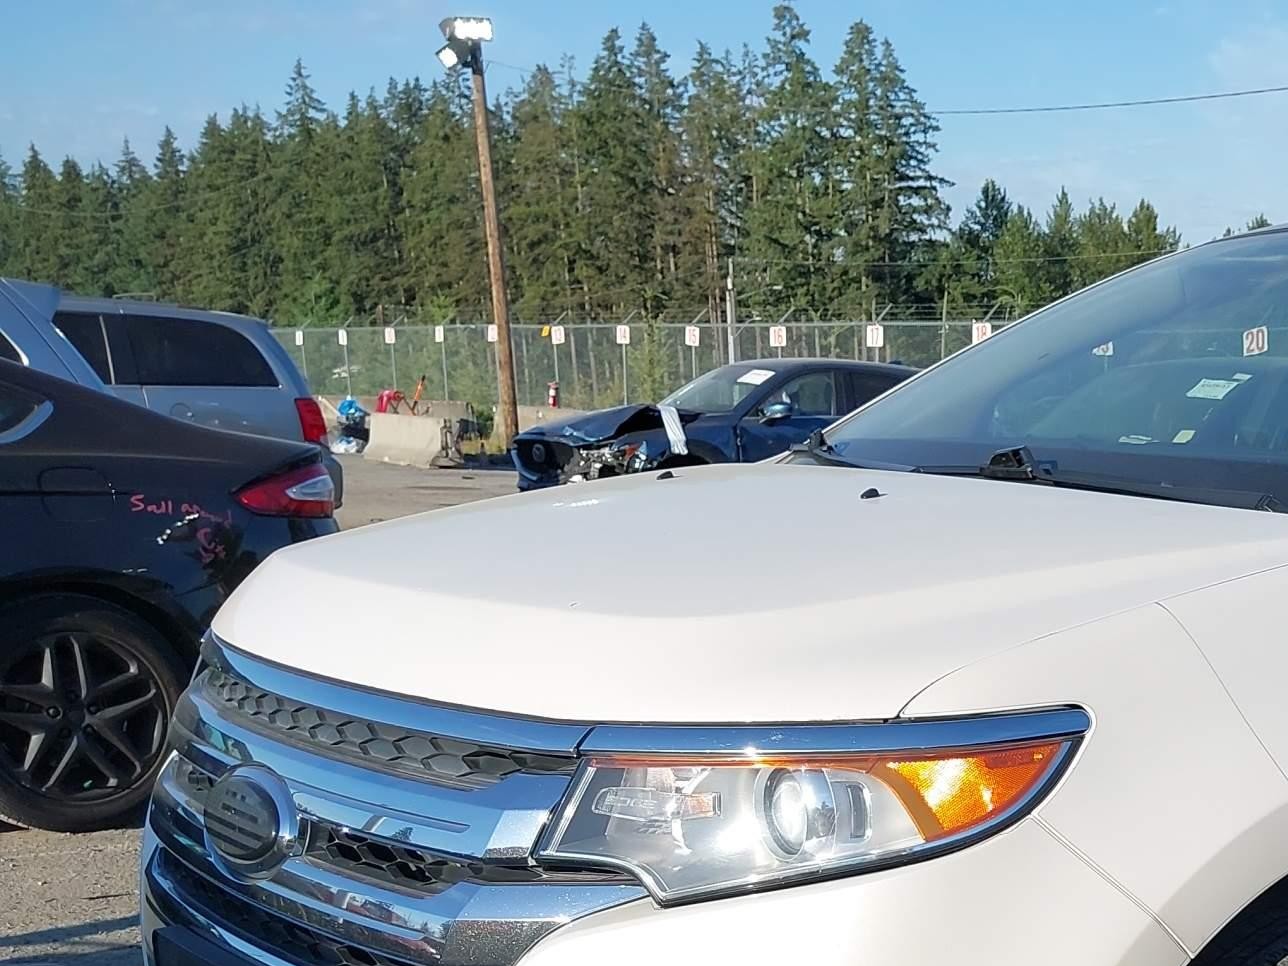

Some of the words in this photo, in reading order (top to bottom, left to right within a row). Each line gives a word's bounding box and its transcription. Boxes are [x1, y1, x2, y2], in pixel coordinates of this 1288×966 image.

[687, 328, 697, 345] 15
[773, 327, 784, 345] 16
[870, 326, 880, 345] 17
[1245, 328, 1266, 353] 20
